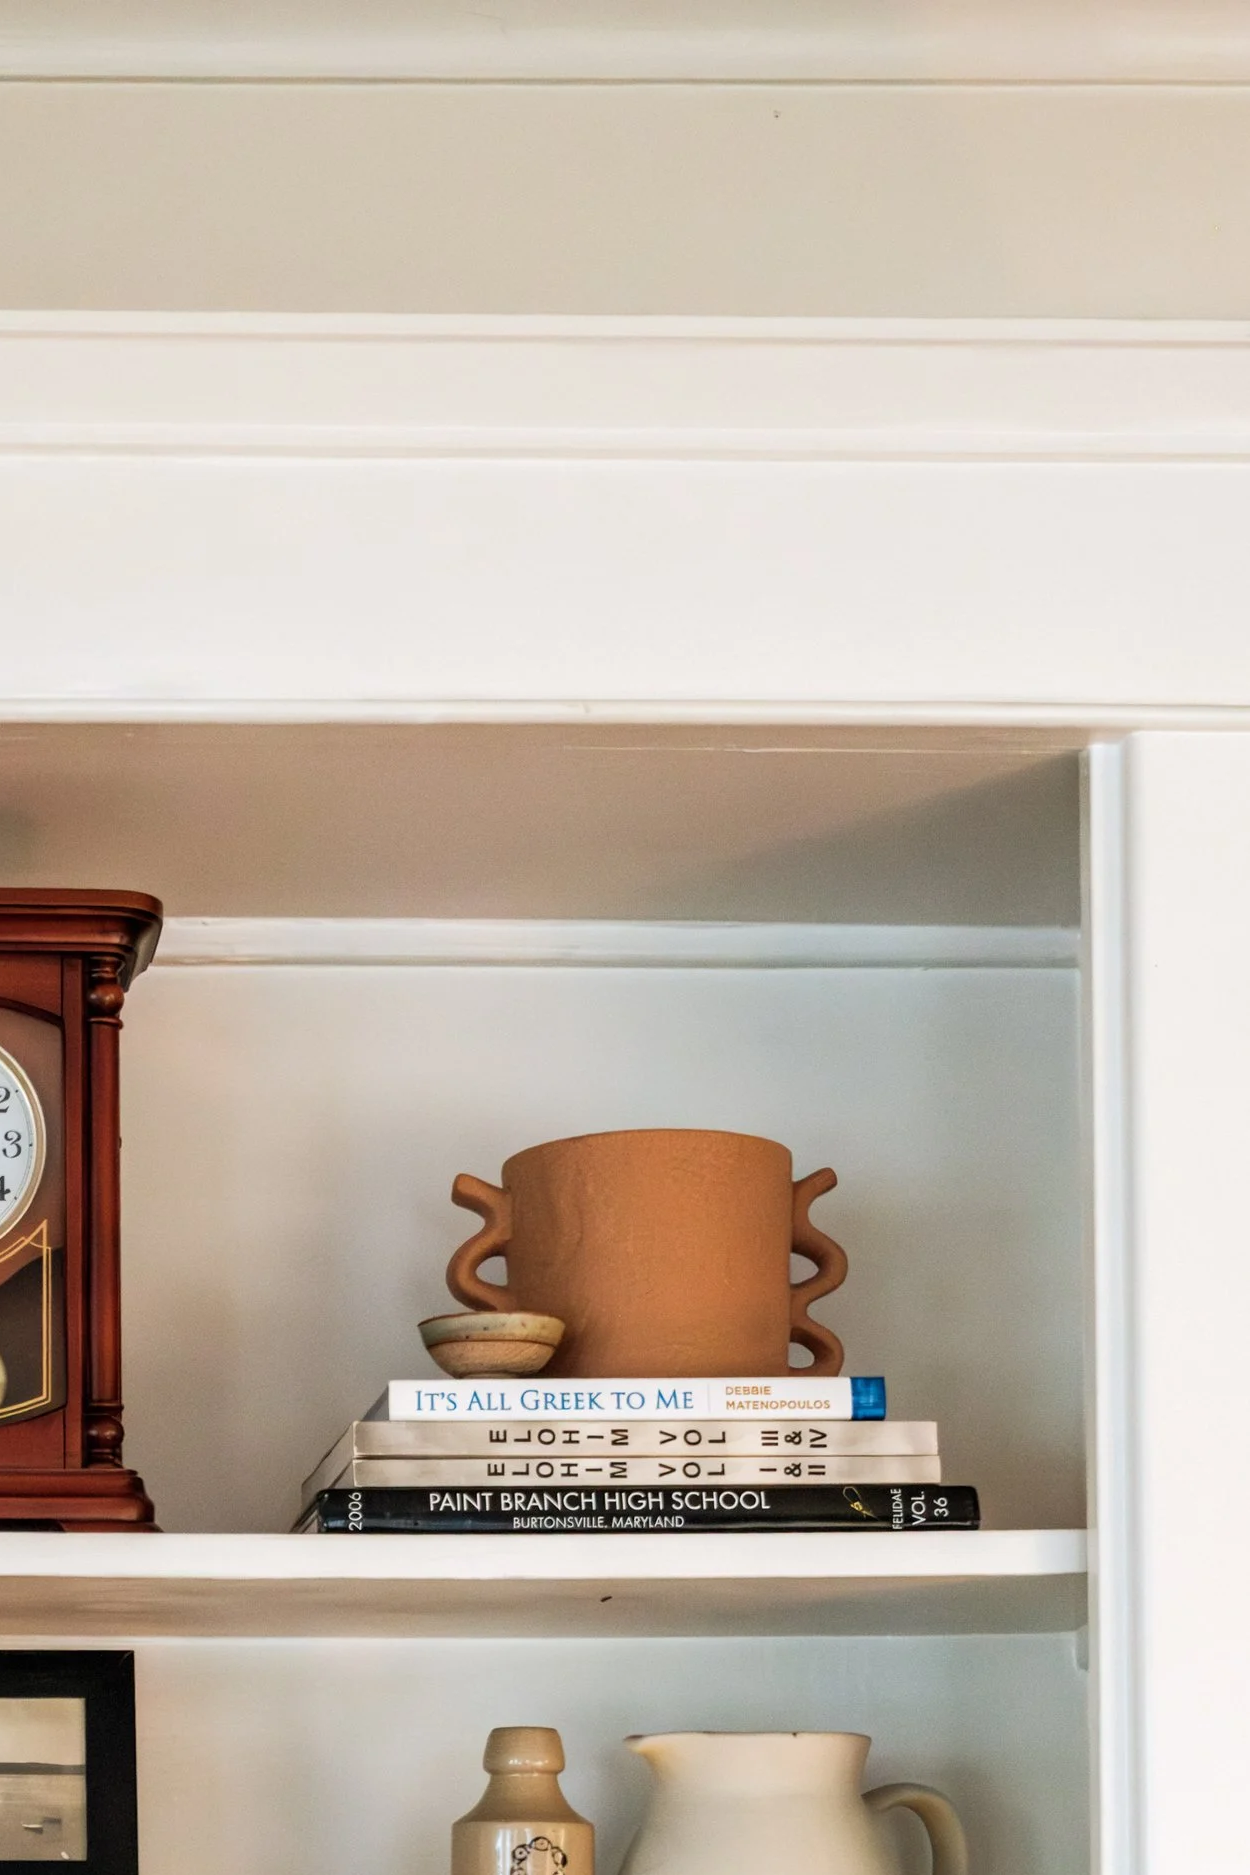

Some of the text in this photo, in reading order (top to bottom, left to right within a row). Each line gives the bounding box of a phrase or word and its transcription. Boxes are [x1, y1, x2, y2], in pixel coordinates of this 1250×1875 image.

[2, 1130, 22, 1158] 3
[725, 1386, 771, 1395] DEBBIE
[726, 1400, 831, 1410] MATENOPOULOS
[489, 1429, 629, 1446] ELOHIM
[659, 1429, 726, 1446] VOL
[784, 1430, 802, 1445] &
[809, 1428, 827, 1448] IV
[487, 1461, 628, 1478] ELOHIM
[658, 1462, 725, 1478] VOL
[784, 1462, 802, 1477] &
[429, 1491, 771, 1511] PAINT BRANCH HIGH SCHOOL
[892, 1488, 902, 1530] FELIDAE
[911, 1490, 926, 1526] VOL.
[934, 1497, 949, 1517] 36
[348, 1492, 362, 1531] 2006
[612, 1516, 684, 1528] MARYLAND
